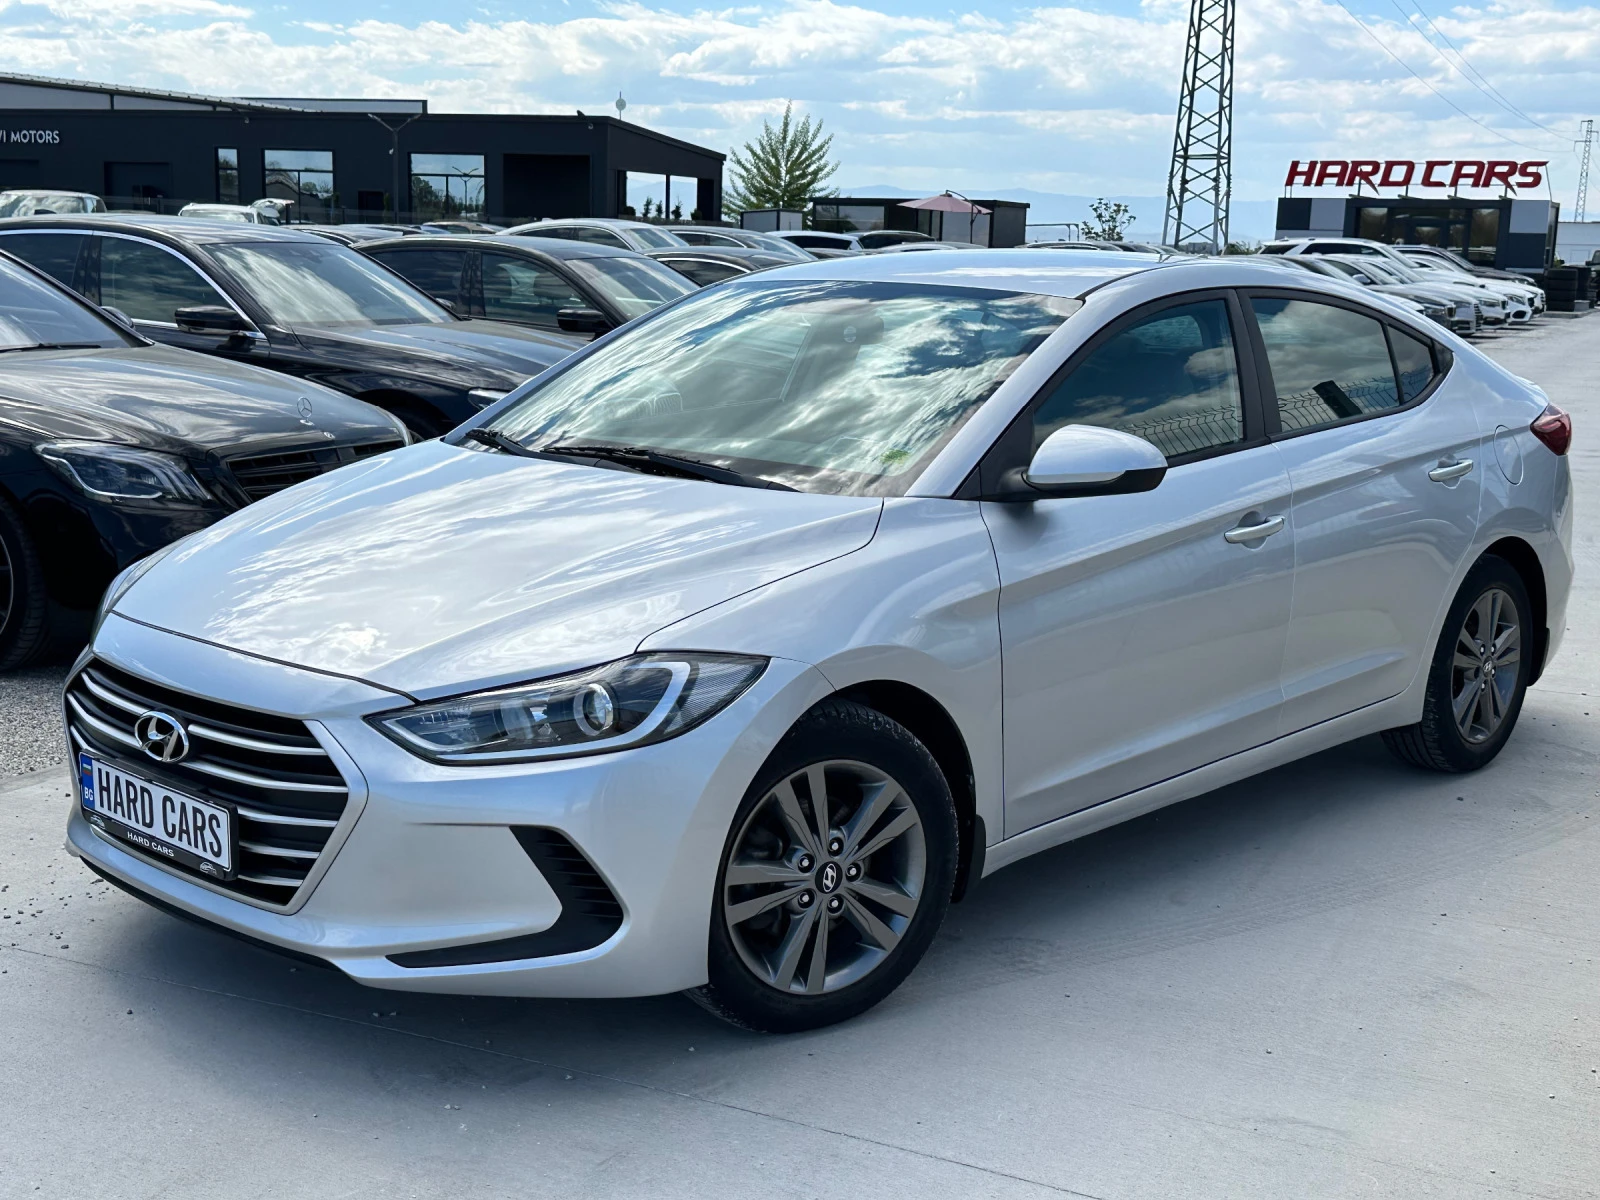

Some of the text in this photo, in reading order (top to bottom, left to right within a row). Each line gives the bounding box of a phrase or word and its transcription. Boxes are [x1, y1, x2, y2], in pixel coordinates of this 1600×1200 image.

[10, 129, 60, 144] MOTORS
[1285, 160, 1550, 197] HARD CARS
[84, 786, 94, 801] BG
[98, 767, 222, 858] HARD CARS
[127, 831, 175, 858] HARD CARS
